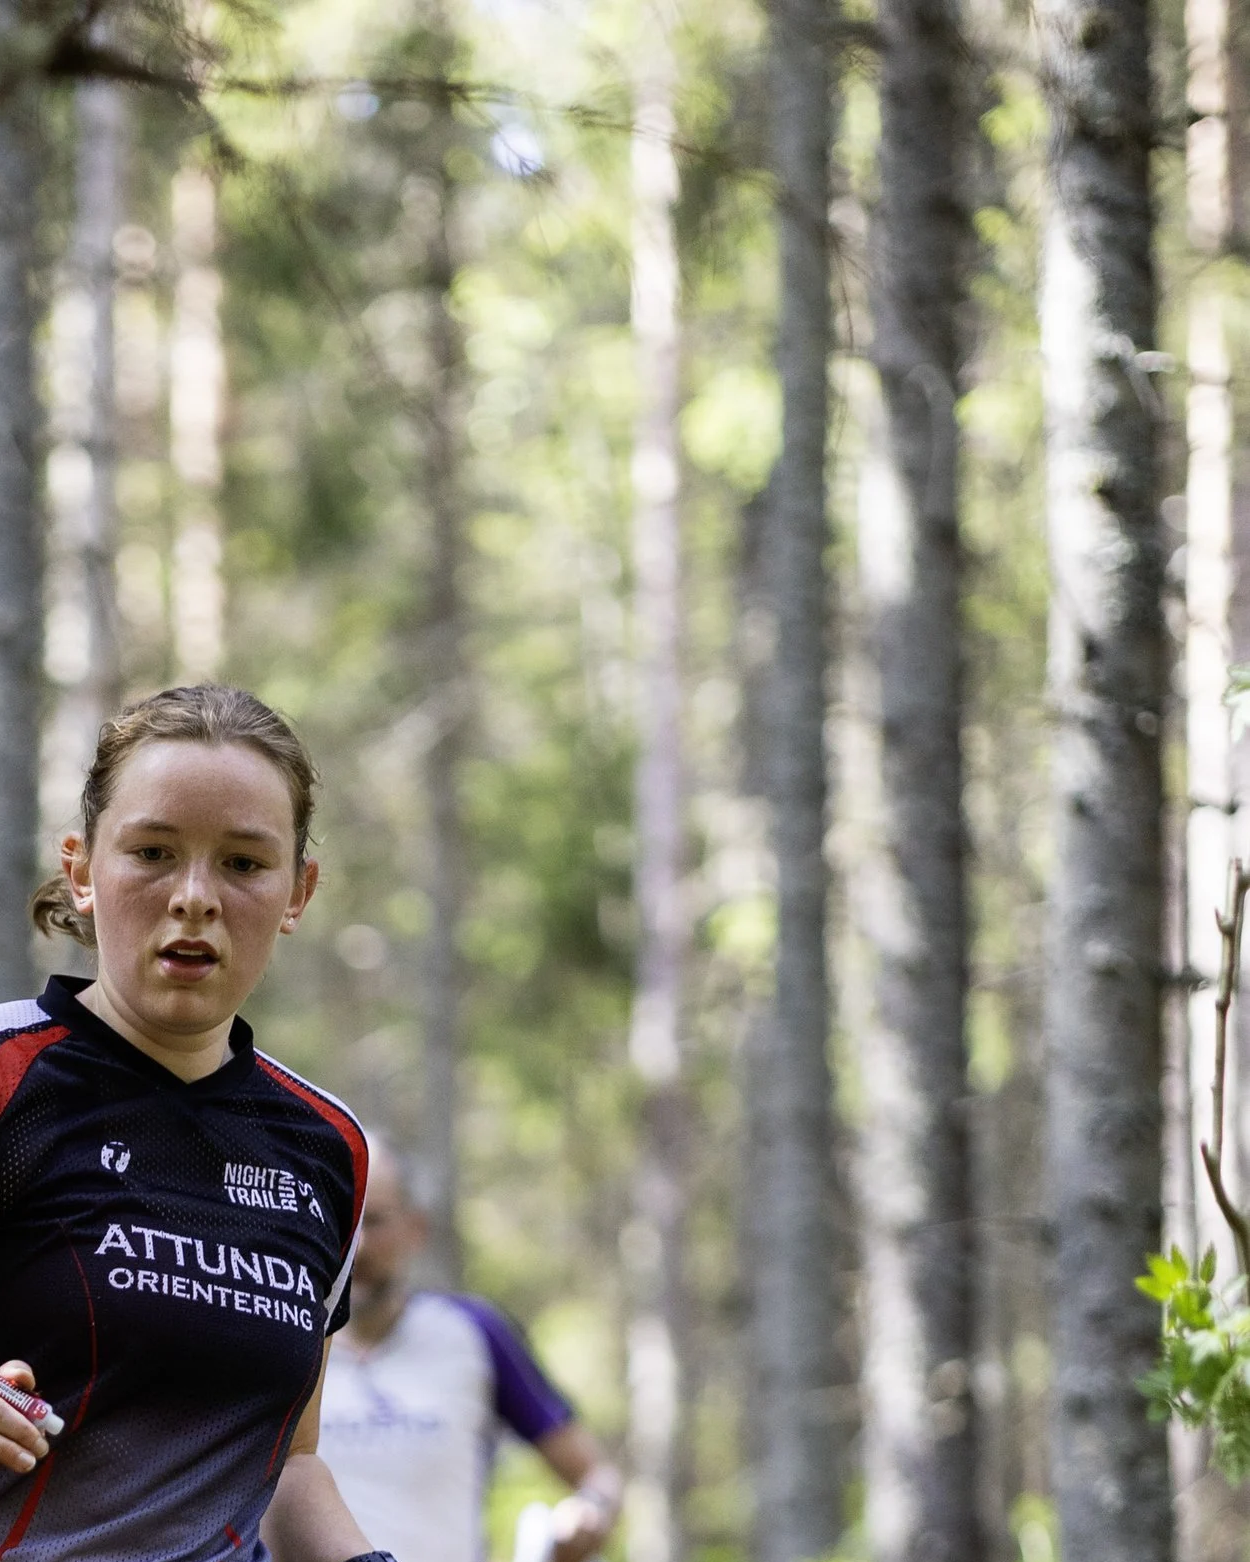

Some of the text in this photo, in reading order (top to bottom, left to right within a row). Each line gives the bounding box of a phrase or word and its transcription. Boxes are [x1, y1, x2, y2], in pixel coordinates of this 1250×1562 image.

[224, 1162, 279, 1189] NIGHT
[278, 1170, 298, 1212] RUN
[224, 1185, 282, 1210] TRAIL
[94, 1223, 316, 1303] ATTUNDA
[108, 1267, 314, 1331] ORIENTERING
